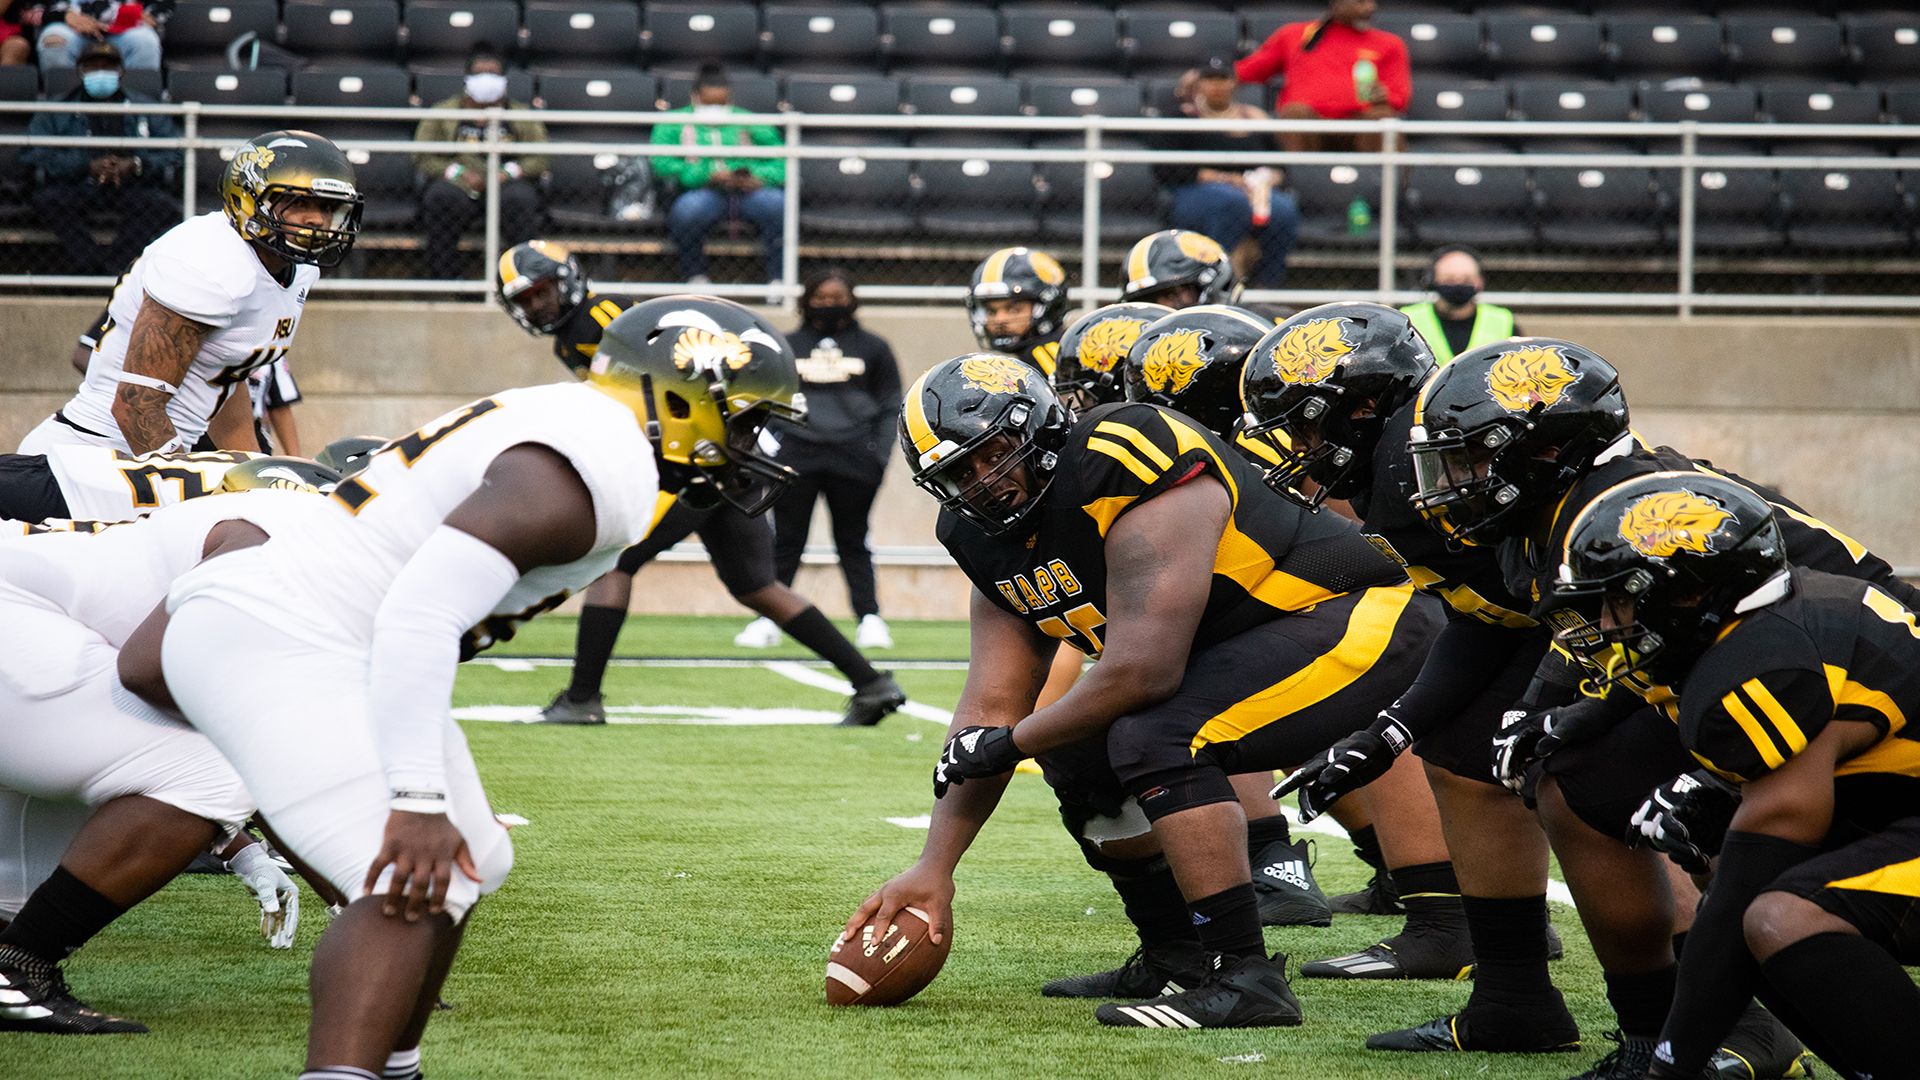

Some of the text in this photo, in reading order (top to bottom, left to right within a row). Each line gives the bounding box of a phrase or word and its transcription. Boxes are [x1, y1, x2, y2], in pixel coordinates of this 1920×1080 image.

[995, 558, 1083, 614] UAPB
[1263, 866, 1310, 891] adidas
[882, 935, 910, 964] DIME
